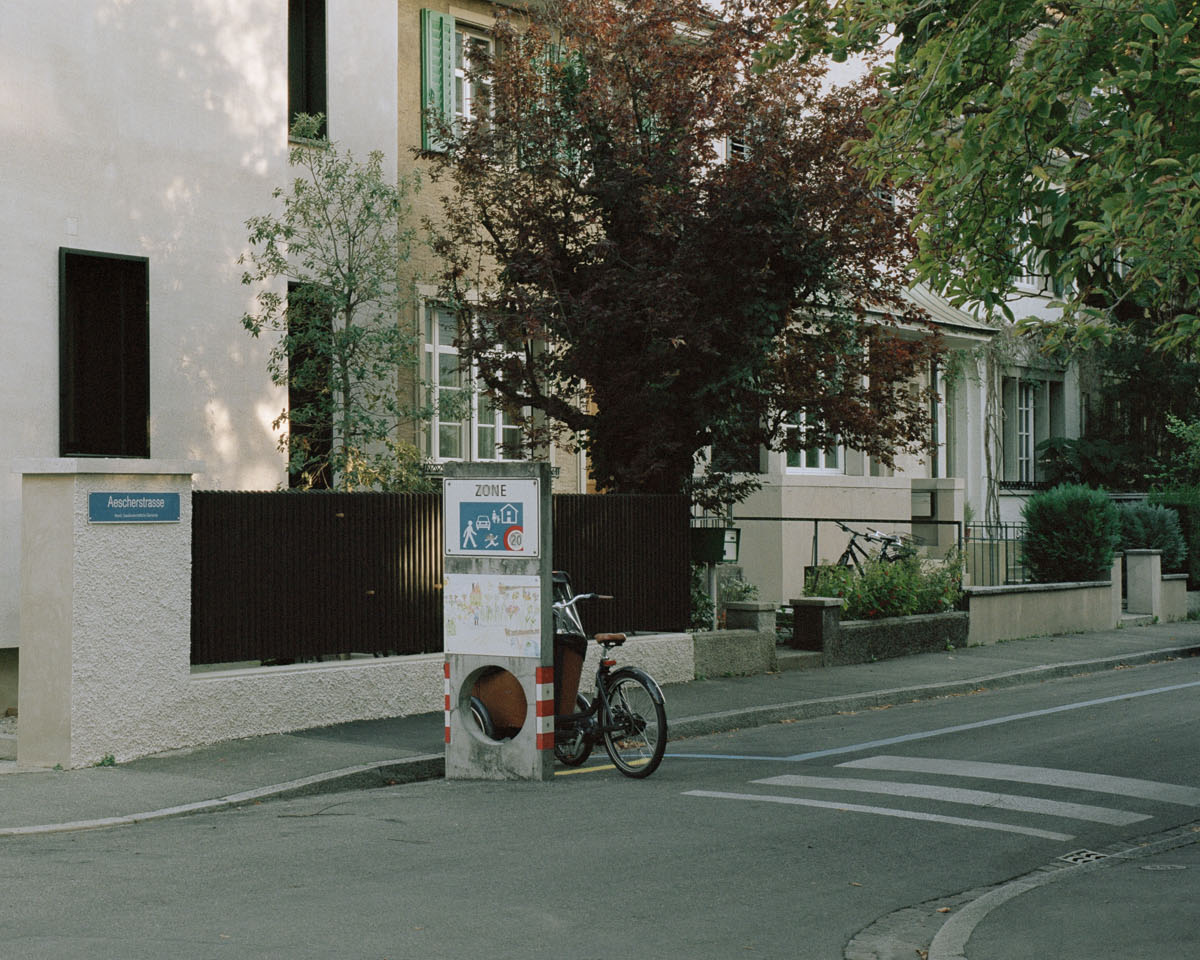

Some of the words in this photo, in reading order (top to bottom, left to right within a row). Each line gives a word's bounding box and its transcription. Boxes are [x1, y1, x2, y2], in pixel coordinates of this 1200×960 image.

[475, 484, 507, 497] ZONE
[107, 495, 165, 508] Aescherstrasse
[510, 534, 522, 546] 20
